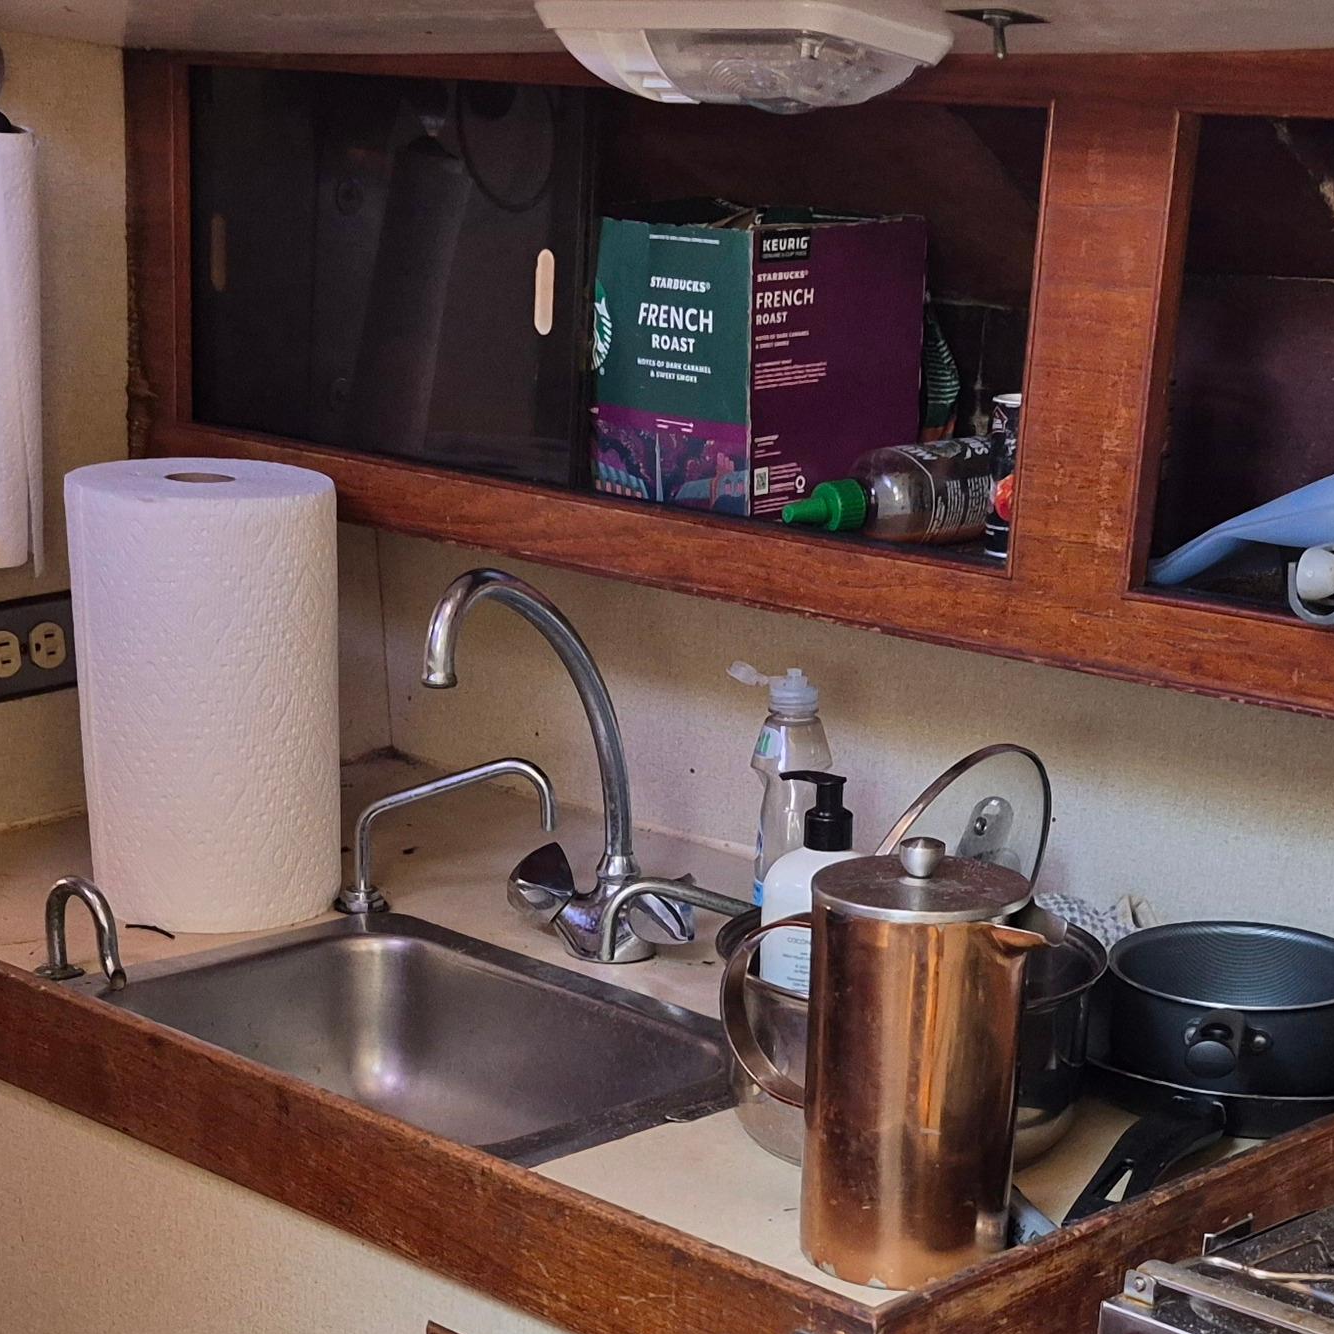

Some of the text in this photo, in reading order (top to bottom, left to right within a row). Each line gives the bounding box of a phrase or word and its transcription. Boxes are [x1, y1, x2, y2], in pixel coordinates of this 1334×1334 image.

[763, 236, 809, 252] KEURIG
[650, 276, 706, 293] STARBUCKS
[756, 270, 805, 283] STARBUCKS
[756, 287, 815, 310] FRENCH
[638, 302, 713, 334] FRENCH
[755, 311, 788, 326] ROAST
[651, 333, 695, 354] ROAST
